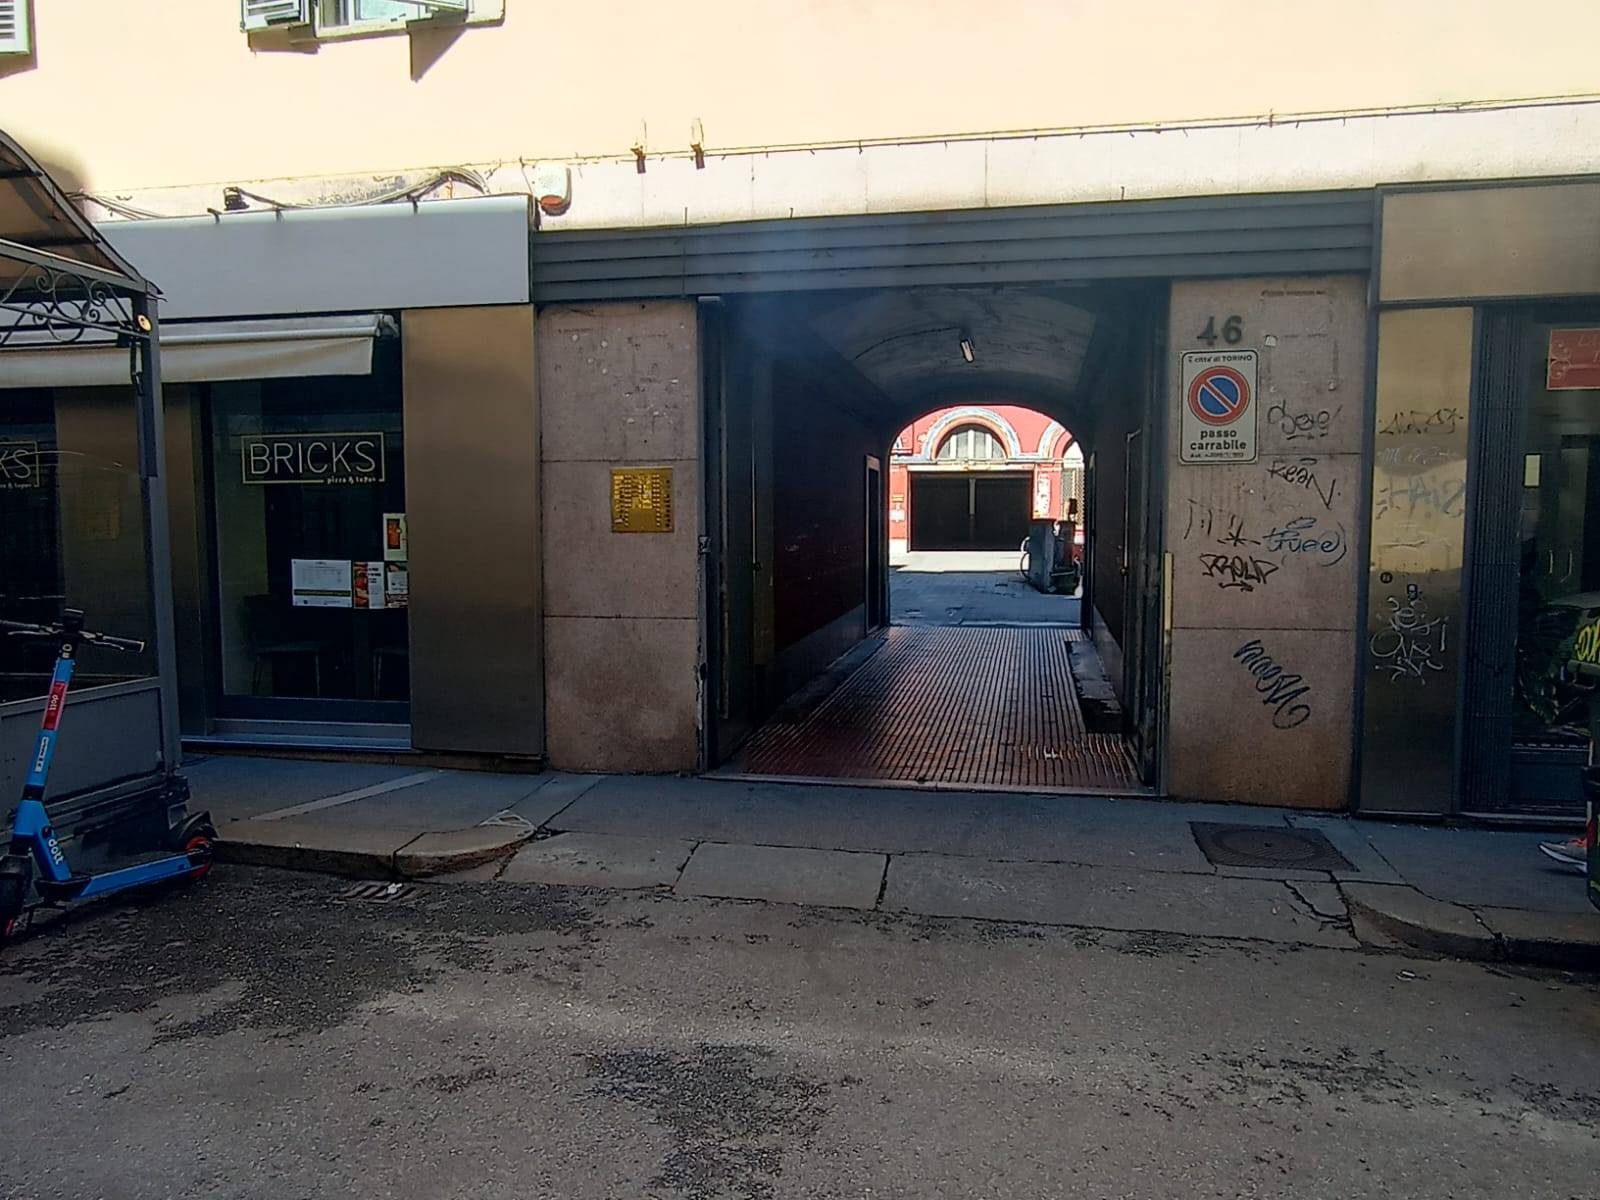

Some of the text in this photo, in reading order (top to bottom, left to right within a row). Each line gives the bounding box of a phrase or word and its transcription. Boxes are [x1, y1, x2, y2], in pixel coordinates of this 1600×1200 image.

[1197, 315, 1242, 346] 46
[1222, 354, 1253, 362] TORINO
[1200, 430, 1237, 440] passo
[1190, 440, 1247, 450] carrabile
[250, 441, 376, 475] BRICKS
[48, 838, 64, 865] dott
